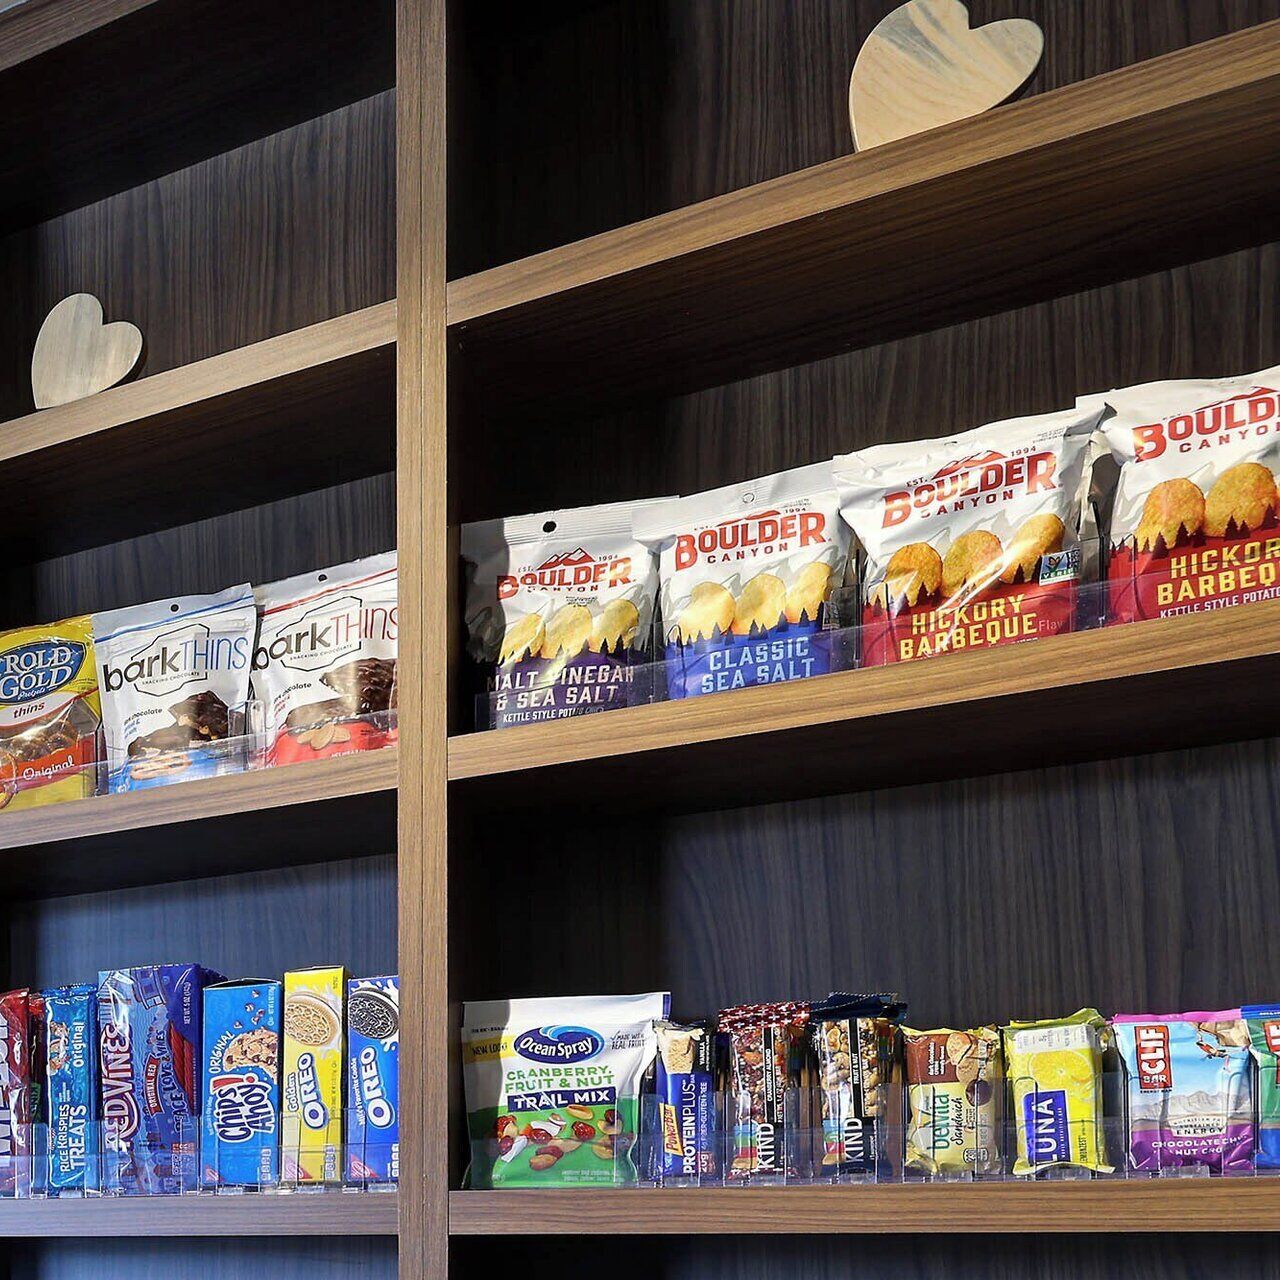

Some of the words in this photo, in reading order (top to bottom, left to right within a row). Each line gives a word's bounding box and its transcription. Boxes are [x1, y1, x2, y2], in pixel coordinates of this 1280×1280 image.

[1011, 445, 1037, 457] 1994
[882, 450, 1057, 528] BOULDER
[675, 512, 827, 571] BOULDER
[707, 542, 788, 564] CANYON
[497, 557, 632, 600] BOULDER
[912, 594, 1026, 635] HICKORY
[1160, 603, 1201, 620] KETTLE
[1204, 595, 1239, 612] STYLE
[710, 637, 810, 671] CLASSIC
[900, 613, 1037, 660] BARBEQUE
[4, 646, 73, 675] ROLD
[702, 673, 745, 695] SEA
[757, 657, 815, 684] SALT
[14, 702, 45, 719] thins
[517, 689, 556, 708] SEA
[566, 685, 618, 705] SALT
[503, 710, 530, 723] KETTLE
[533, 709, 557, 721] STYLE
[23, 755, 75, 781] Original
[72, 1022, 84, 1067] original
[209, 1031, 235, 1074] ORIGINAL
[520, 1036, 556, 1057] Ocean
[557, 1037, 594, 1059] Spray
[1140, 1028, 1166, 1075] CLIF
[288, 1072, 299, 1113] Golden
[297, 1052, 329, 1130] OREO
[354, 1083, 364, 1111] Favorite
[360, 1046, 395, 1128] OREO
[506, 1078, 552, 1093] FRUIT
[559, 1078, 570, 1088] &
[577, 1075, 615, 1087] NUT
[1142, 1075, 1167, 1083] BAR
[514, 1094, 568, 1109] TRAIL
[575, 1090, 610, 1103] MIX
[59, 1104, 70, 1151] KRISPIES
[70, 1105, 87, 1170] TREATS
[951, 1097, 964, 1145] Sandwich
[1035, 1098, 1058, 1166] LUNA
[844, 1118, 864, 1163] KIND
[1152, 1137, 1220, 1148] CHOCOLATE
[60, 1152, 70, 1173] RICE
